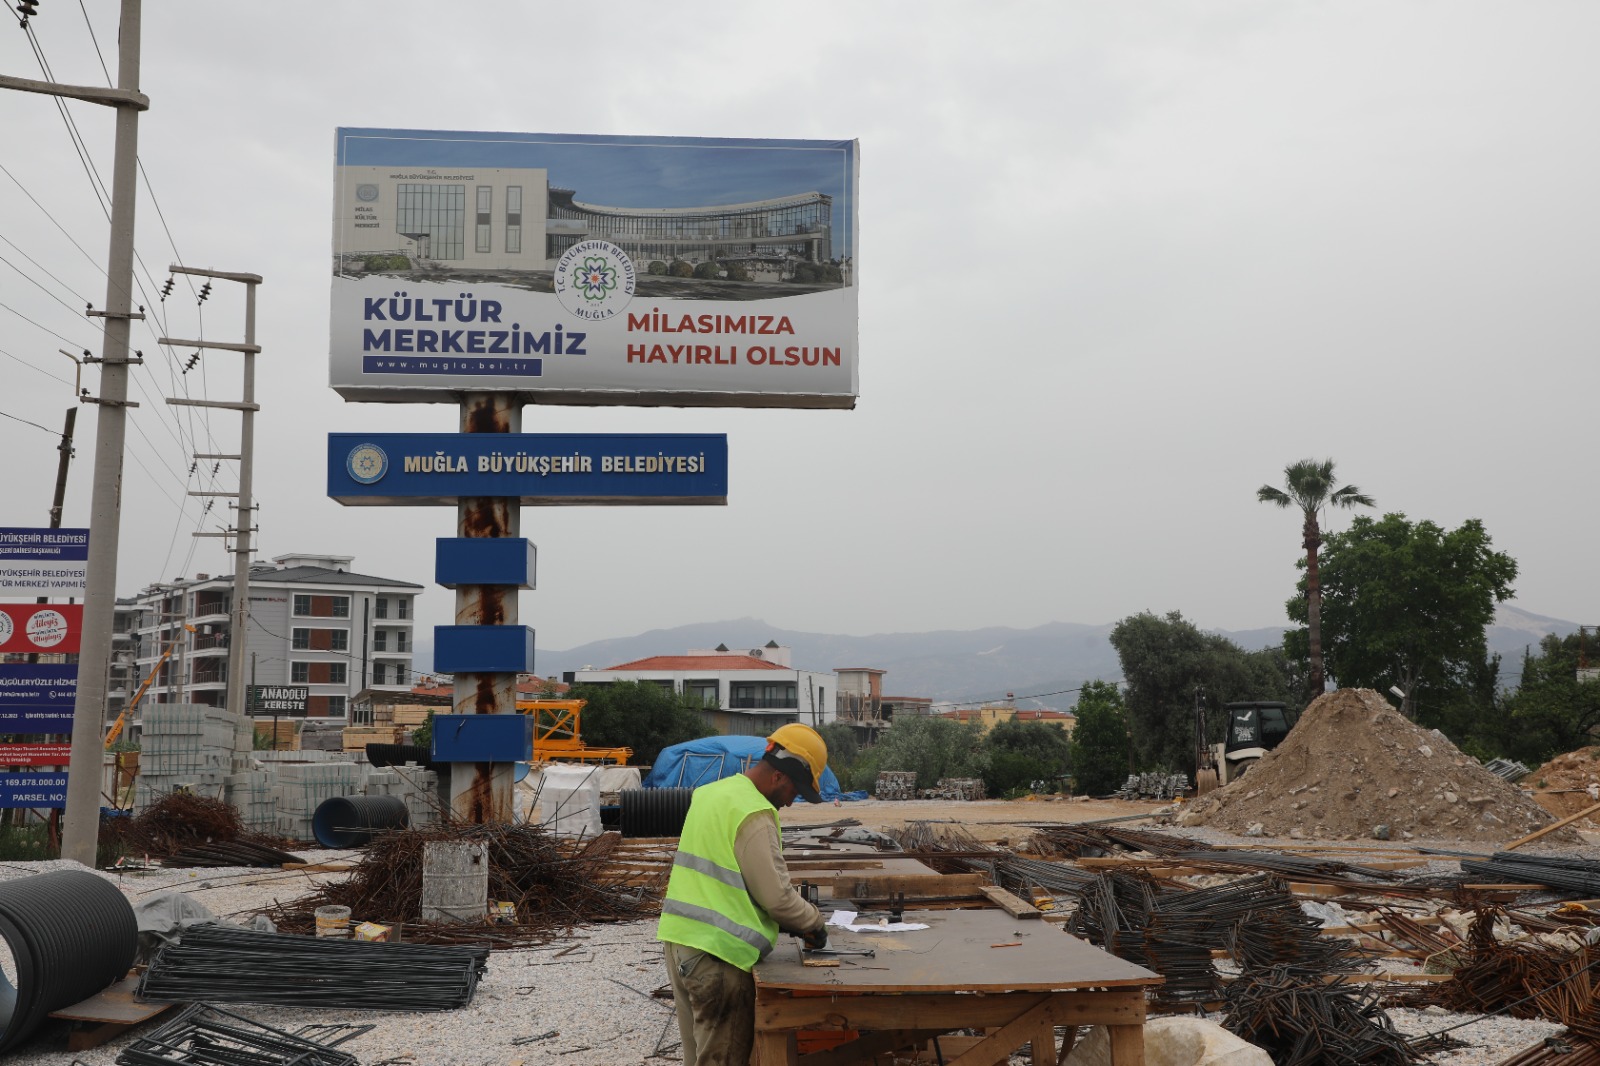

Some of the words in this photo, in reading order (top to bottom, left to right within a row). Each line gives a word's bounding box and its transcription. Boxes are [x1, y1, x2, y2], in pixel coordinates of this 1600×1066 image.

[559, 242, 609, 272] BÜYÜKŞEHİR
[611, 248, 634, 295] BELEDİYESİ
[557, 276, 566, 293] T.C.
[363, 292, 502, 323] KÜLTÜR
[575, 308, 614, 319] MUĞLA
[627, 307, 795, 335] MİLASIMIZA
[363, 323, 587, 356] MERKEZİMİZ
[377, 361, 527, 370] www.mugla.bel.tr
[627, 344, 737, 365] HAYIRLI
[747, 346, 841, 367] OLSUN
[404, 451, 469, 473] MUĞLA
[478, 451, 592, 476] BÜYÜKŞEHİR
[602, 452, 705, 473] BELEDİYESİ
[43, 534, 86, 544] BELEDİYESİ
[42, 569, 85, 577] BELEDİYESİ
[261, 688, 307, 700] ANADOLU
[264, 701, 305, 710] KERESTE
